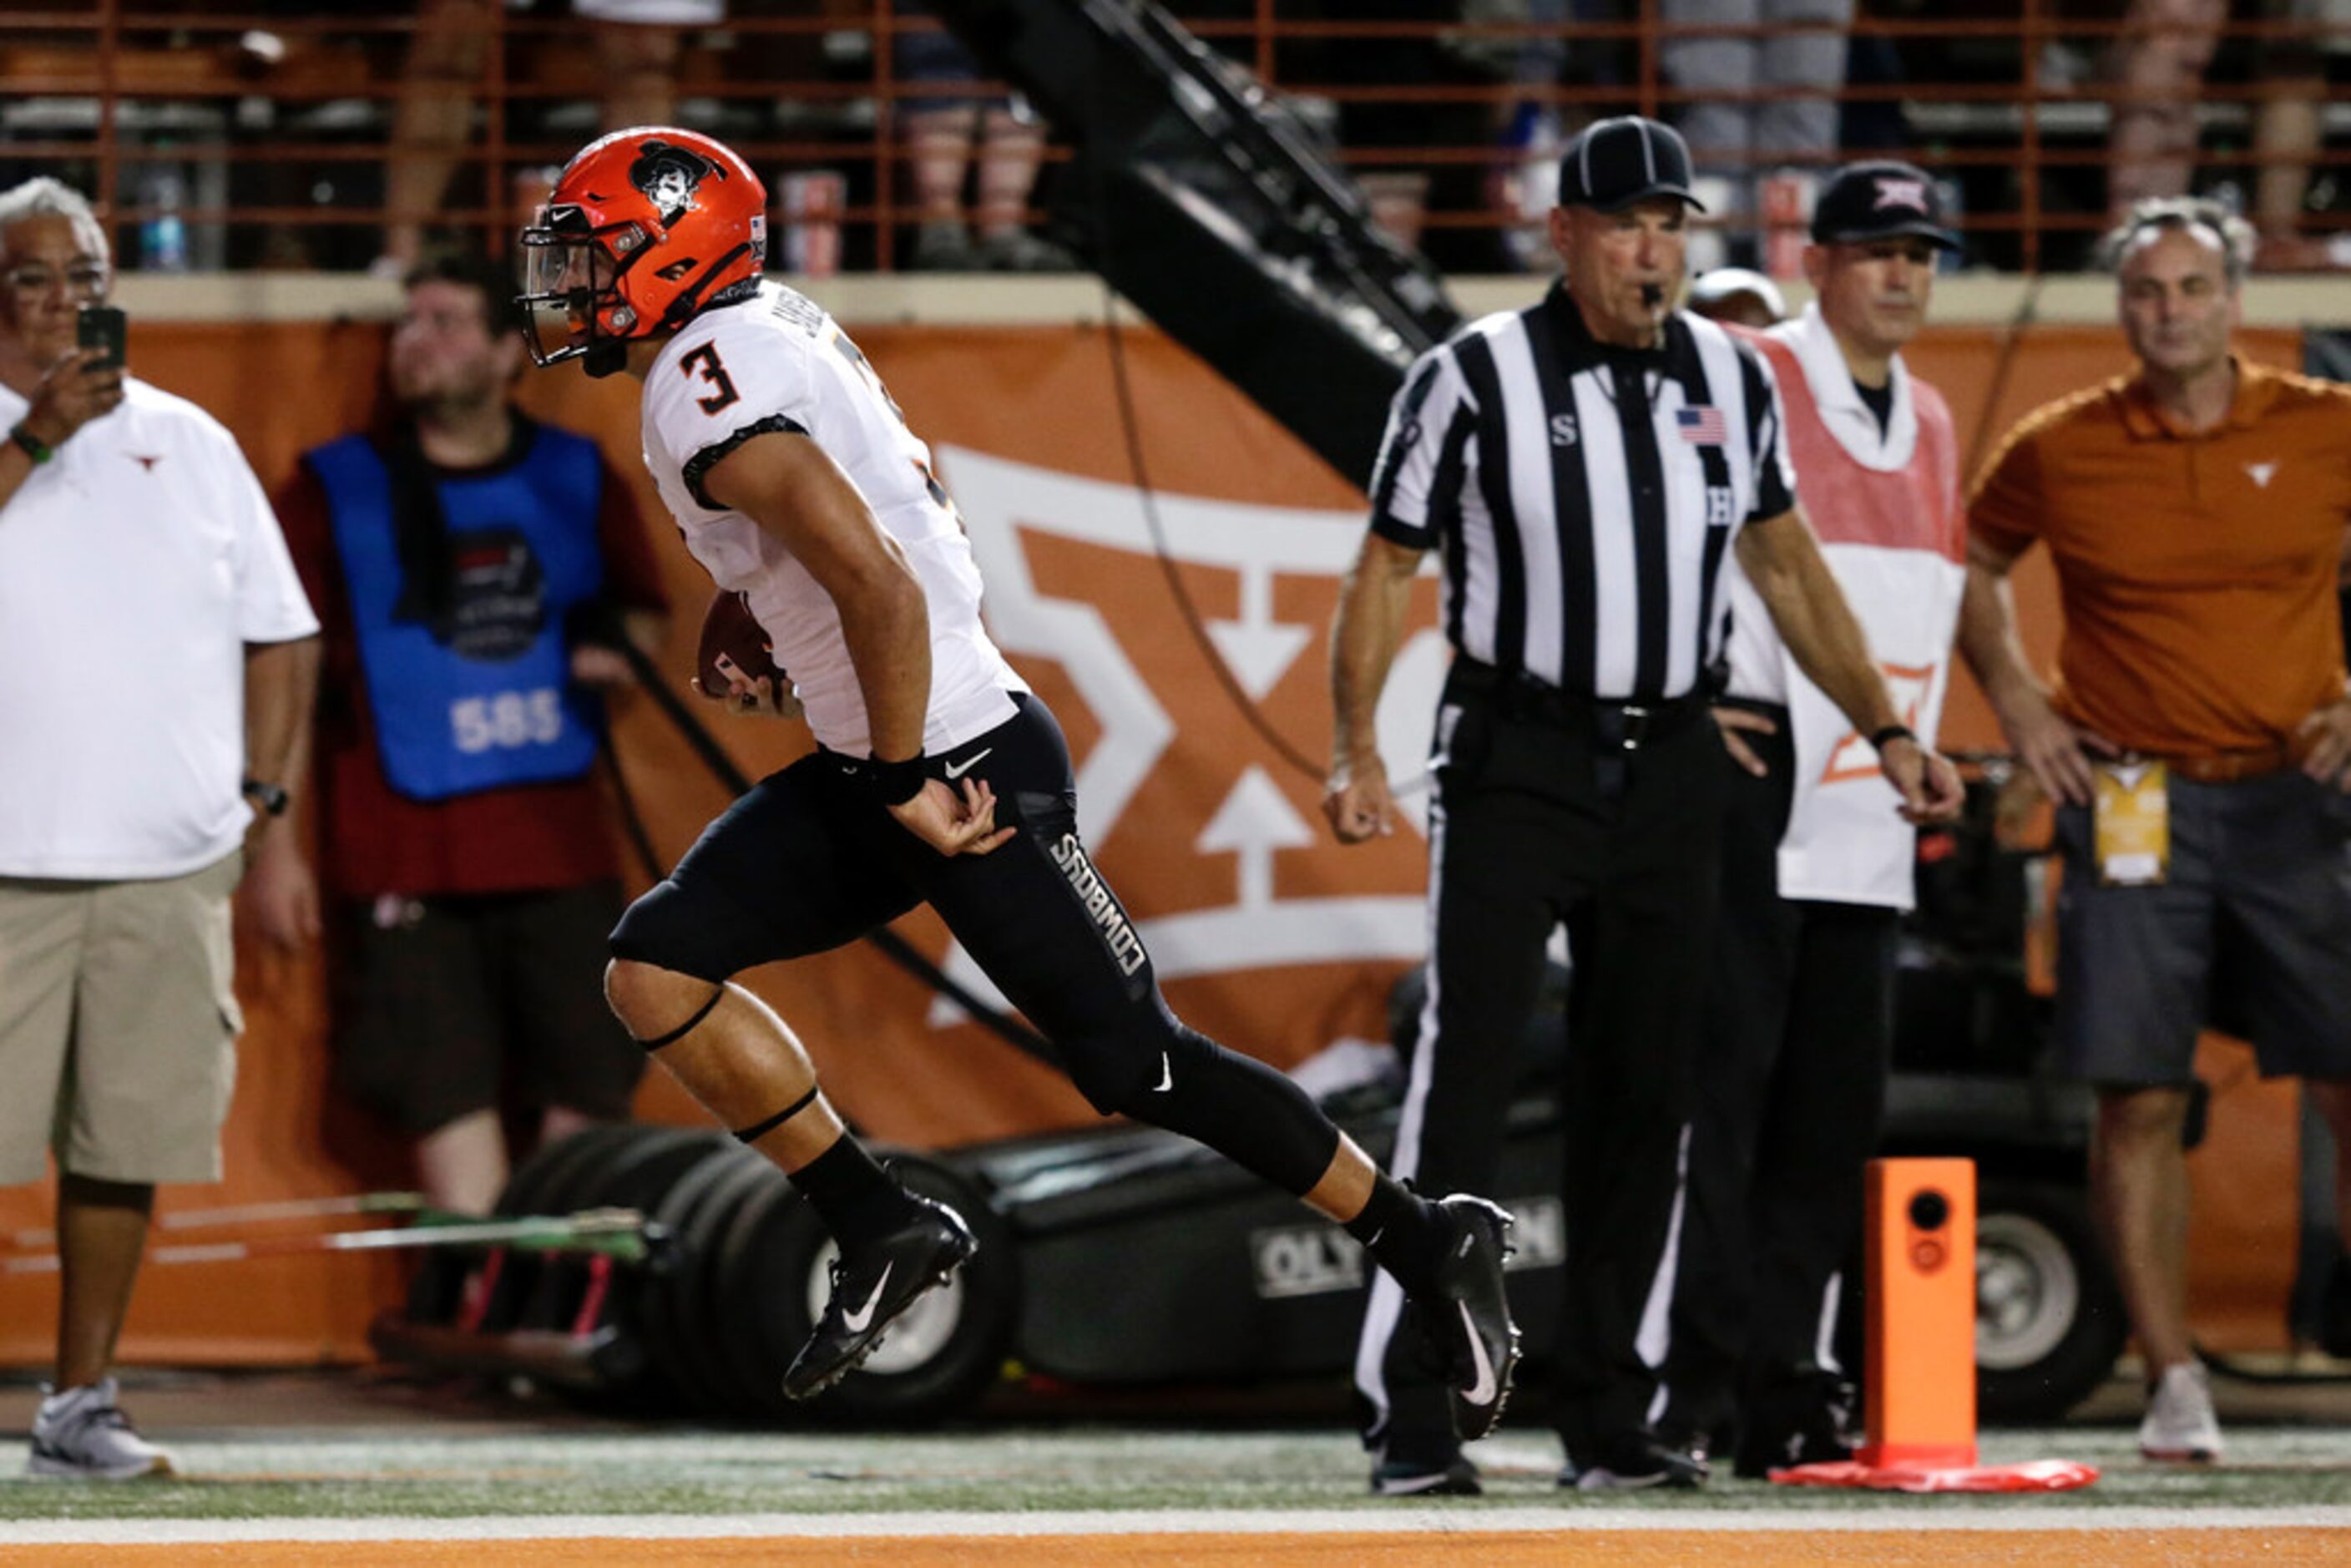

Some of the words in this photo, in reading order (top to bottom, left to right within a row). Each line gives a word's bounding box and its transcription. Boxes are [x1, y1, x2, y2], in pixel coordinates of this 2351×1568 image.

[679, 336, 741, 417] 3
[1550, 414, 1578, 446] S
[1708, 486, 1733, 525] H
[1049, 833, 1146, 977] COWBOYS
